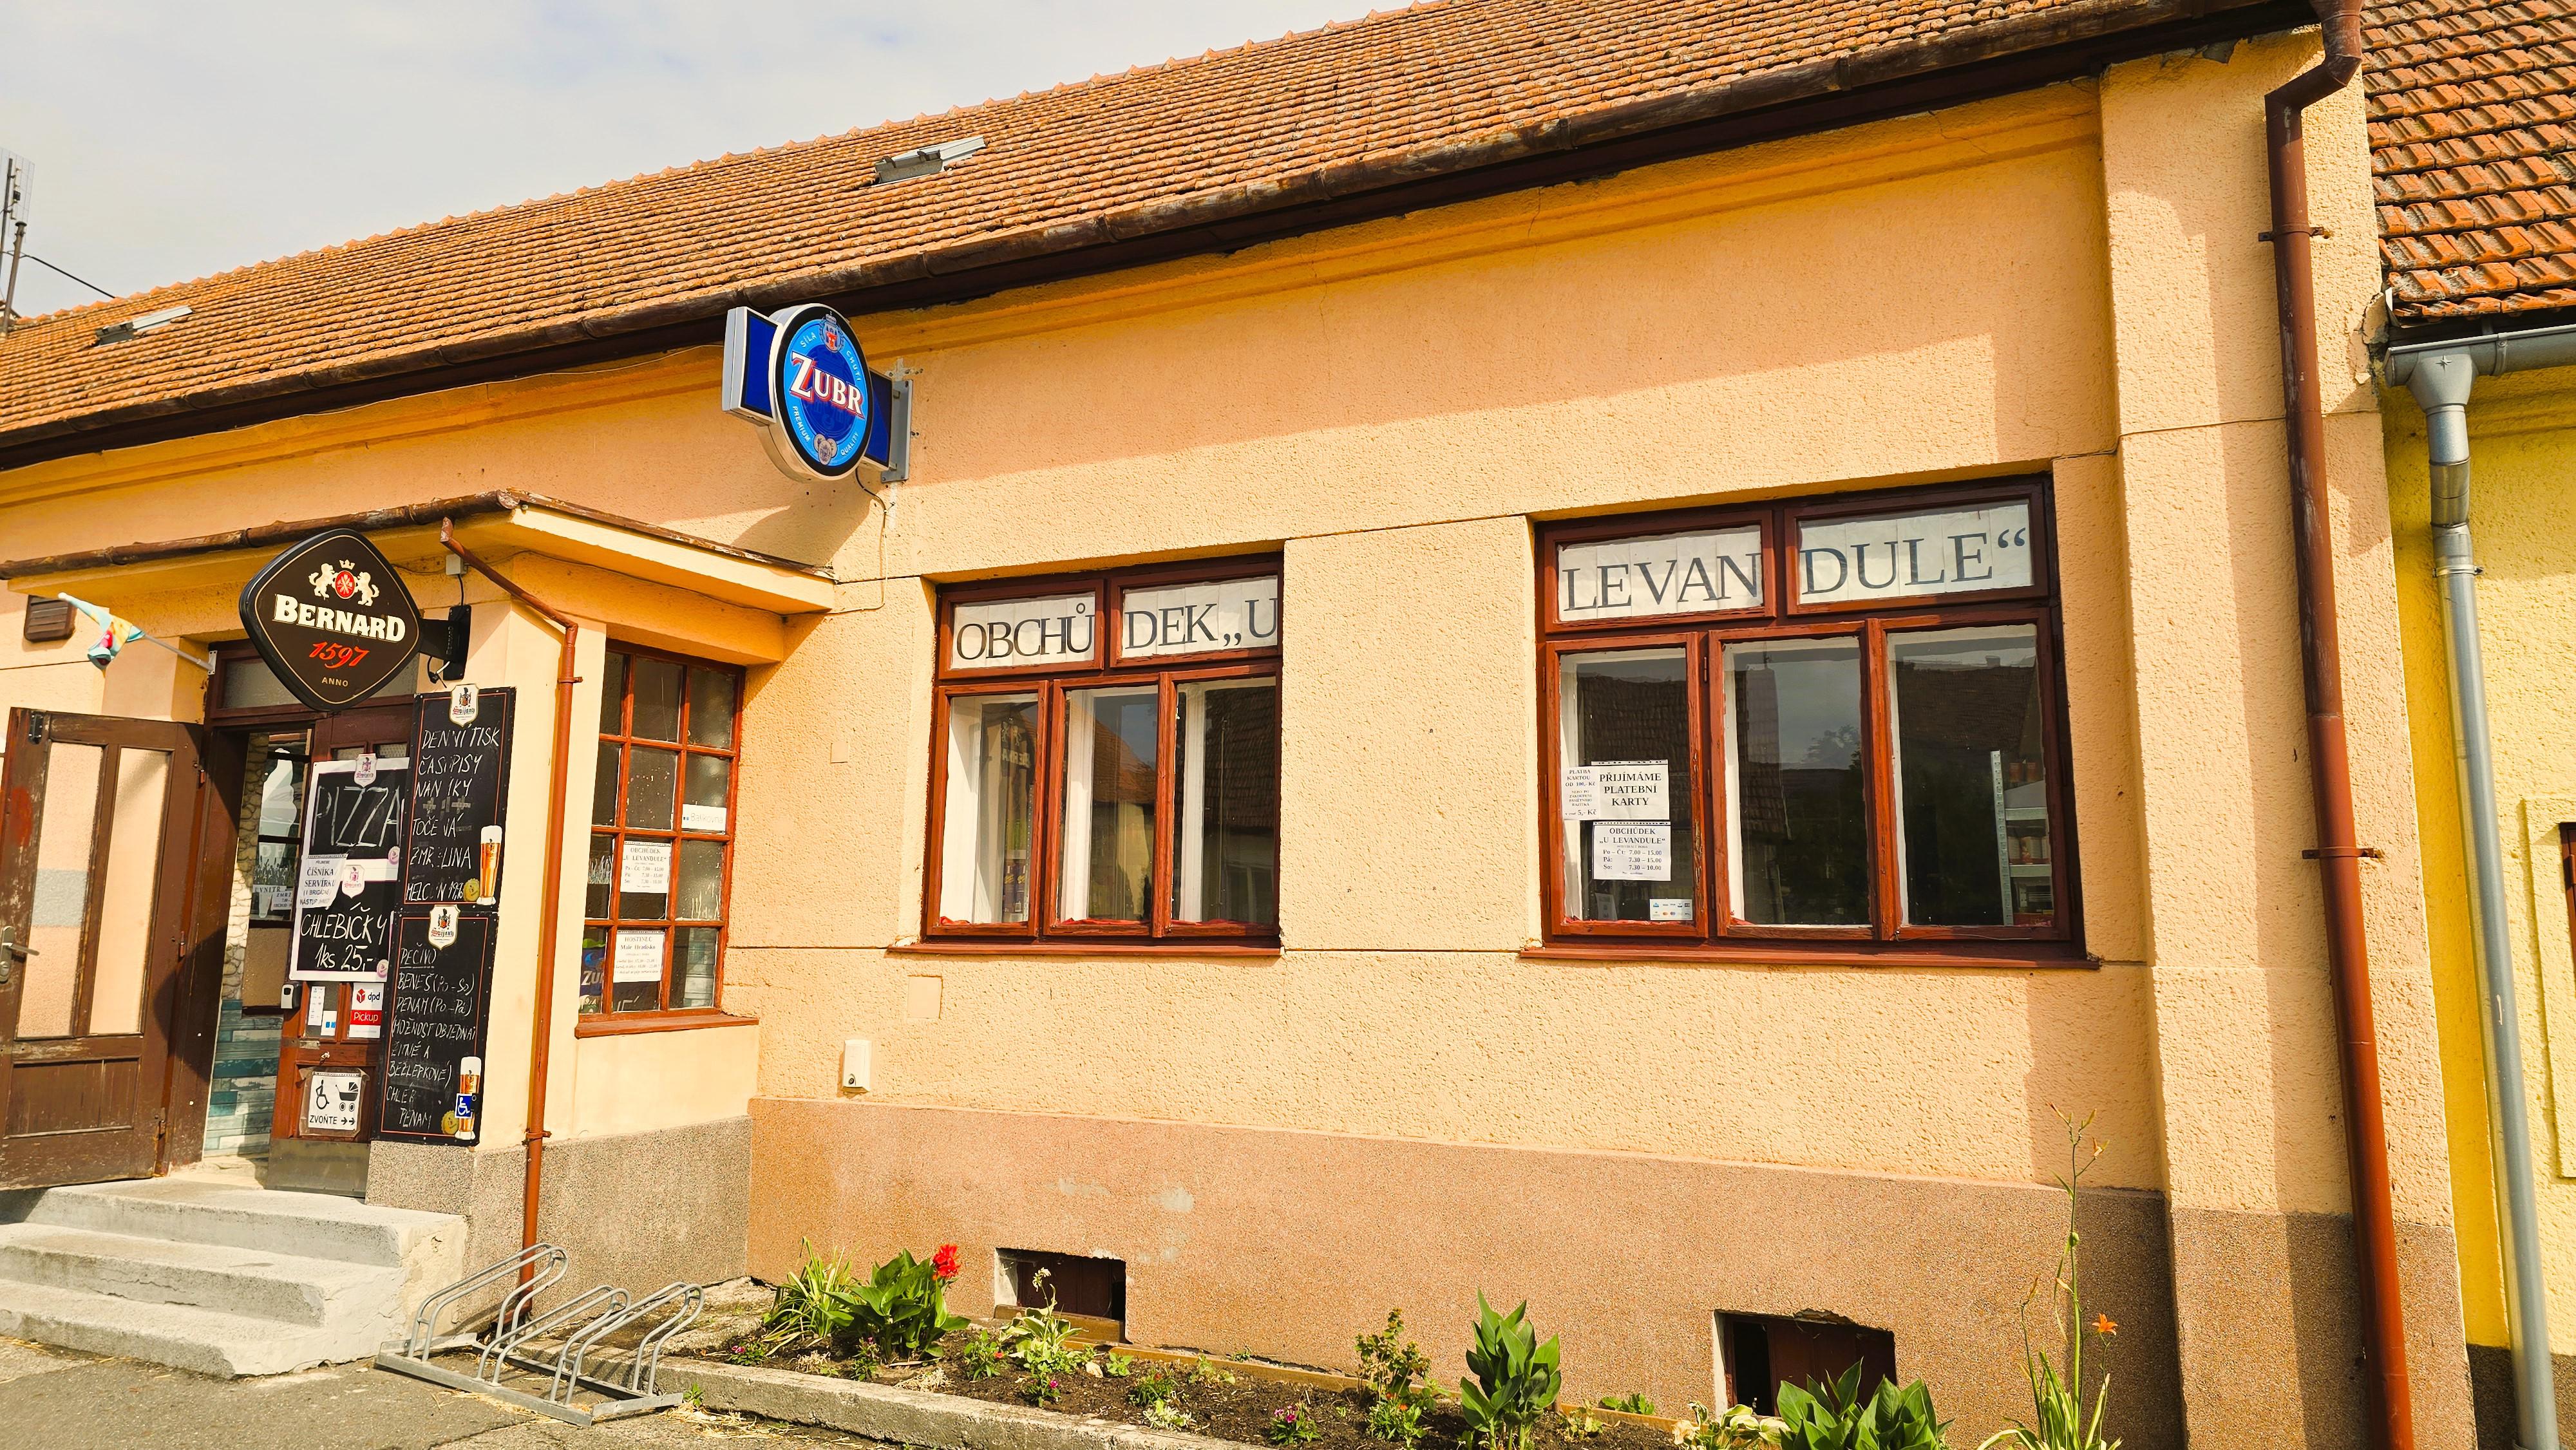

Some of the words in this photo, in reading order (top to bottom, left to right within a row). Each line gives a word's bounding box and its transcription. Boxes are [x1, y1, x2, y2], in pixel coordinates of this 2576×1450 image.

[790, 351, 865, 419] ZUBR
[793, 406, 811, 442] PREMIUM
[840, 432, 859, 456] QUALITY
[1562, 552, 1761, 611] LEVAN
[272, 594, 406, 643] BERNARD
[956, 603, 1094, 660] OBCHŮ
[309, 642, 370, 668] 1597
[321, 677, 348, 687] ANNO
[469, 726, 500, 747] TISK
[1600, 772, 1662, 782] PŘIJÍMÁME
[1604, 784, 1657, 794] PLATEBNÍ
[312, 784, 400, 847] PIZZA
[307, 867, 334, 876] ČÍŠNÍKA
[300, 901, 388, 945] CHLEBÍČKY
[315, 943, 336, 968] 1ks
[581, 970, 604, 985] ZU
[368, 992, 381, 1003] dpd
[354, 1012, 379, 1023] Pickup
[310, 1113, 338, 1125] ZVOŇTE
